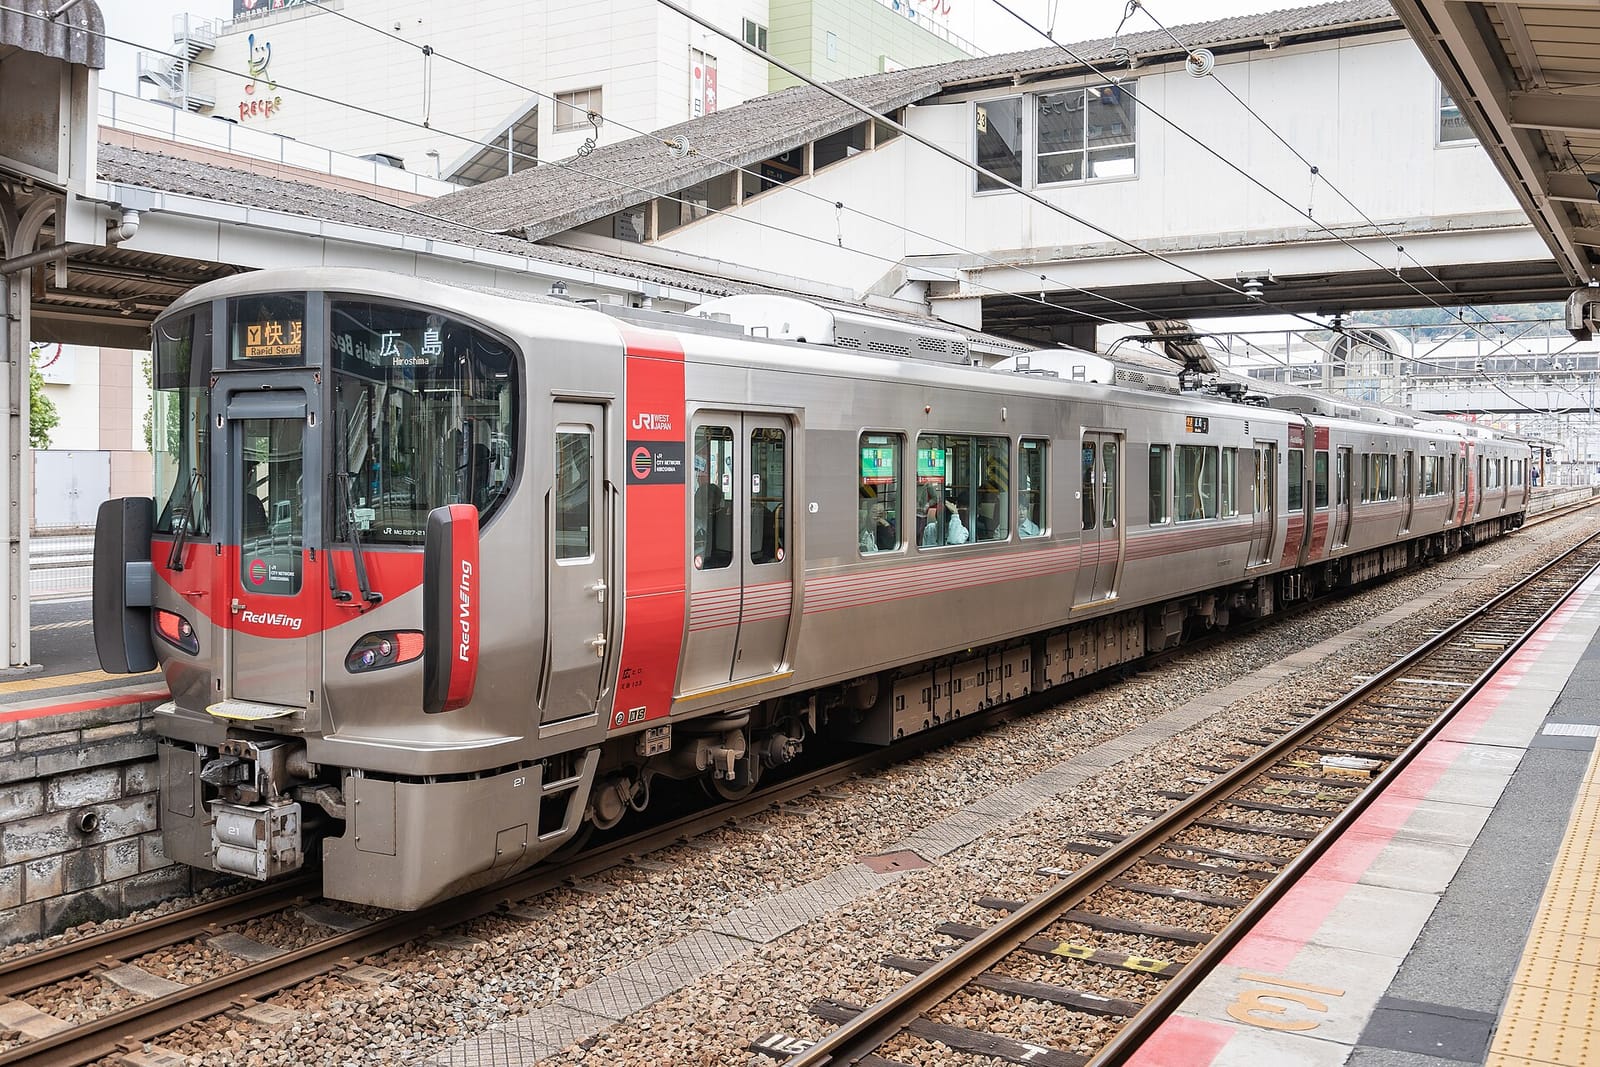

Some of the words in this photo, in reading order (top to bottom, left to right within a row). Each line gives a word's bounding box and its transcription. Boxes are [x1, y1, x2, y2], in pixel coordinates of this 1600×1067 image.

[380, 330, 442, 356] 広島
[251, 347, 273, 356] Rapid
[392, 356, 430, 366] Hiroshima
[632, 413, 650, 430] JR
[654, 414, 670, 422] WEST
[654, 422, 672, 430] JAPAN
[513, 776, 526, 787] 21
[228, 826, 240, 836] 21
